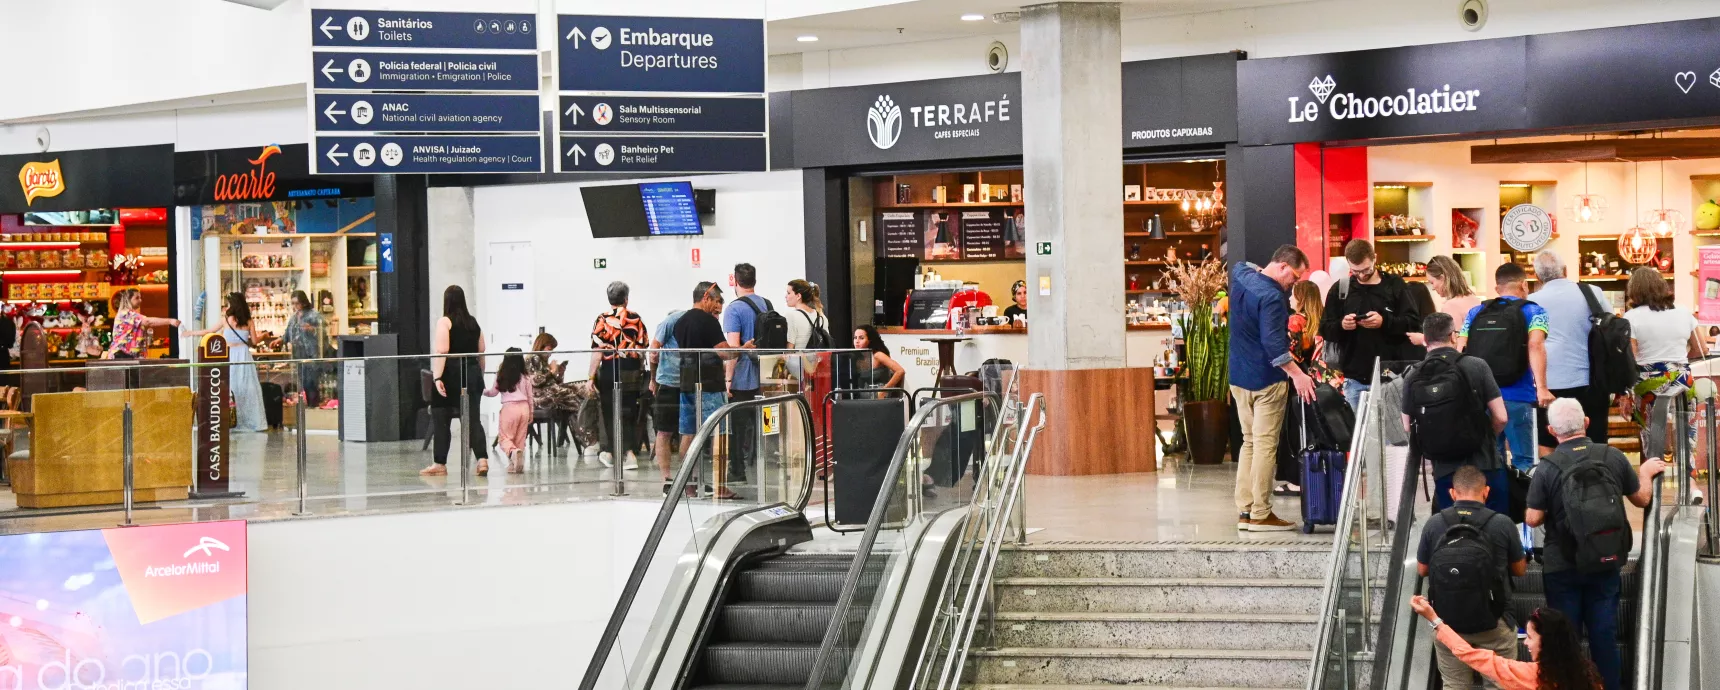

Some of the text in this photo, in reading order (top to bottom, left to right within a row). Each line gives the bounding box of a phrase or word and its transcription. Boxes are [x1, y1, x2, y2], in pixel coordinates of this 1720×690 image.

[378, 18, 432, 29] Sanitários
[378, 31, 412, 41] Toilets
[620, 28, 714, 50] Embarque
[380, 62, 496, 71] Polícia federal Polícia civil
[620, 51, 718, 71] Departures
[380, 72, 512, 82] Immigration Emigration Police
[382, 103, 409, 112] ANAC
[1288, 84, 1480, 123] Le Chocolatier
[620, 106, 701, 114] Sala Multissensorial
[910, 94, 1010, 127] TERRAFÉ
[382, 114, 417, 122] National
[419, 114, 436, 122] civil
[472, 116, 503, 124] agency
[620, 116, 651, 124] Sensory
[934, 128, 980, 139] CAFÉS ESPECIAIS
[1132, 127, 1213, 140] PRODUTOS CAPIXABAS
[413, 146, 481, 154] ANVISA Juizado
[621, 145, 674, 154] Banheiro Pet
[440, 155, 477, 164] regulation
[635, 156, 658, 164] Relief
[25, 166, 59, 190] Garoto
[214, 145, 281, 200] acarte
[1506, 206, 1542, 226] CERTIFICADO
[1534, 221, 1549, 245] VEGANO
[1506, 232, 1534, 248] PRODUTO
[901, 346, 929, 355] Premium
[916, 357, 939, 366] Brazilia
[210, 367, 221, 481] CASA BAUDUCCO
[145, 561, 219, 578] ArcelorMittal
[38, 648, 105, 690] do
[122, 648, 213, 686] ano
